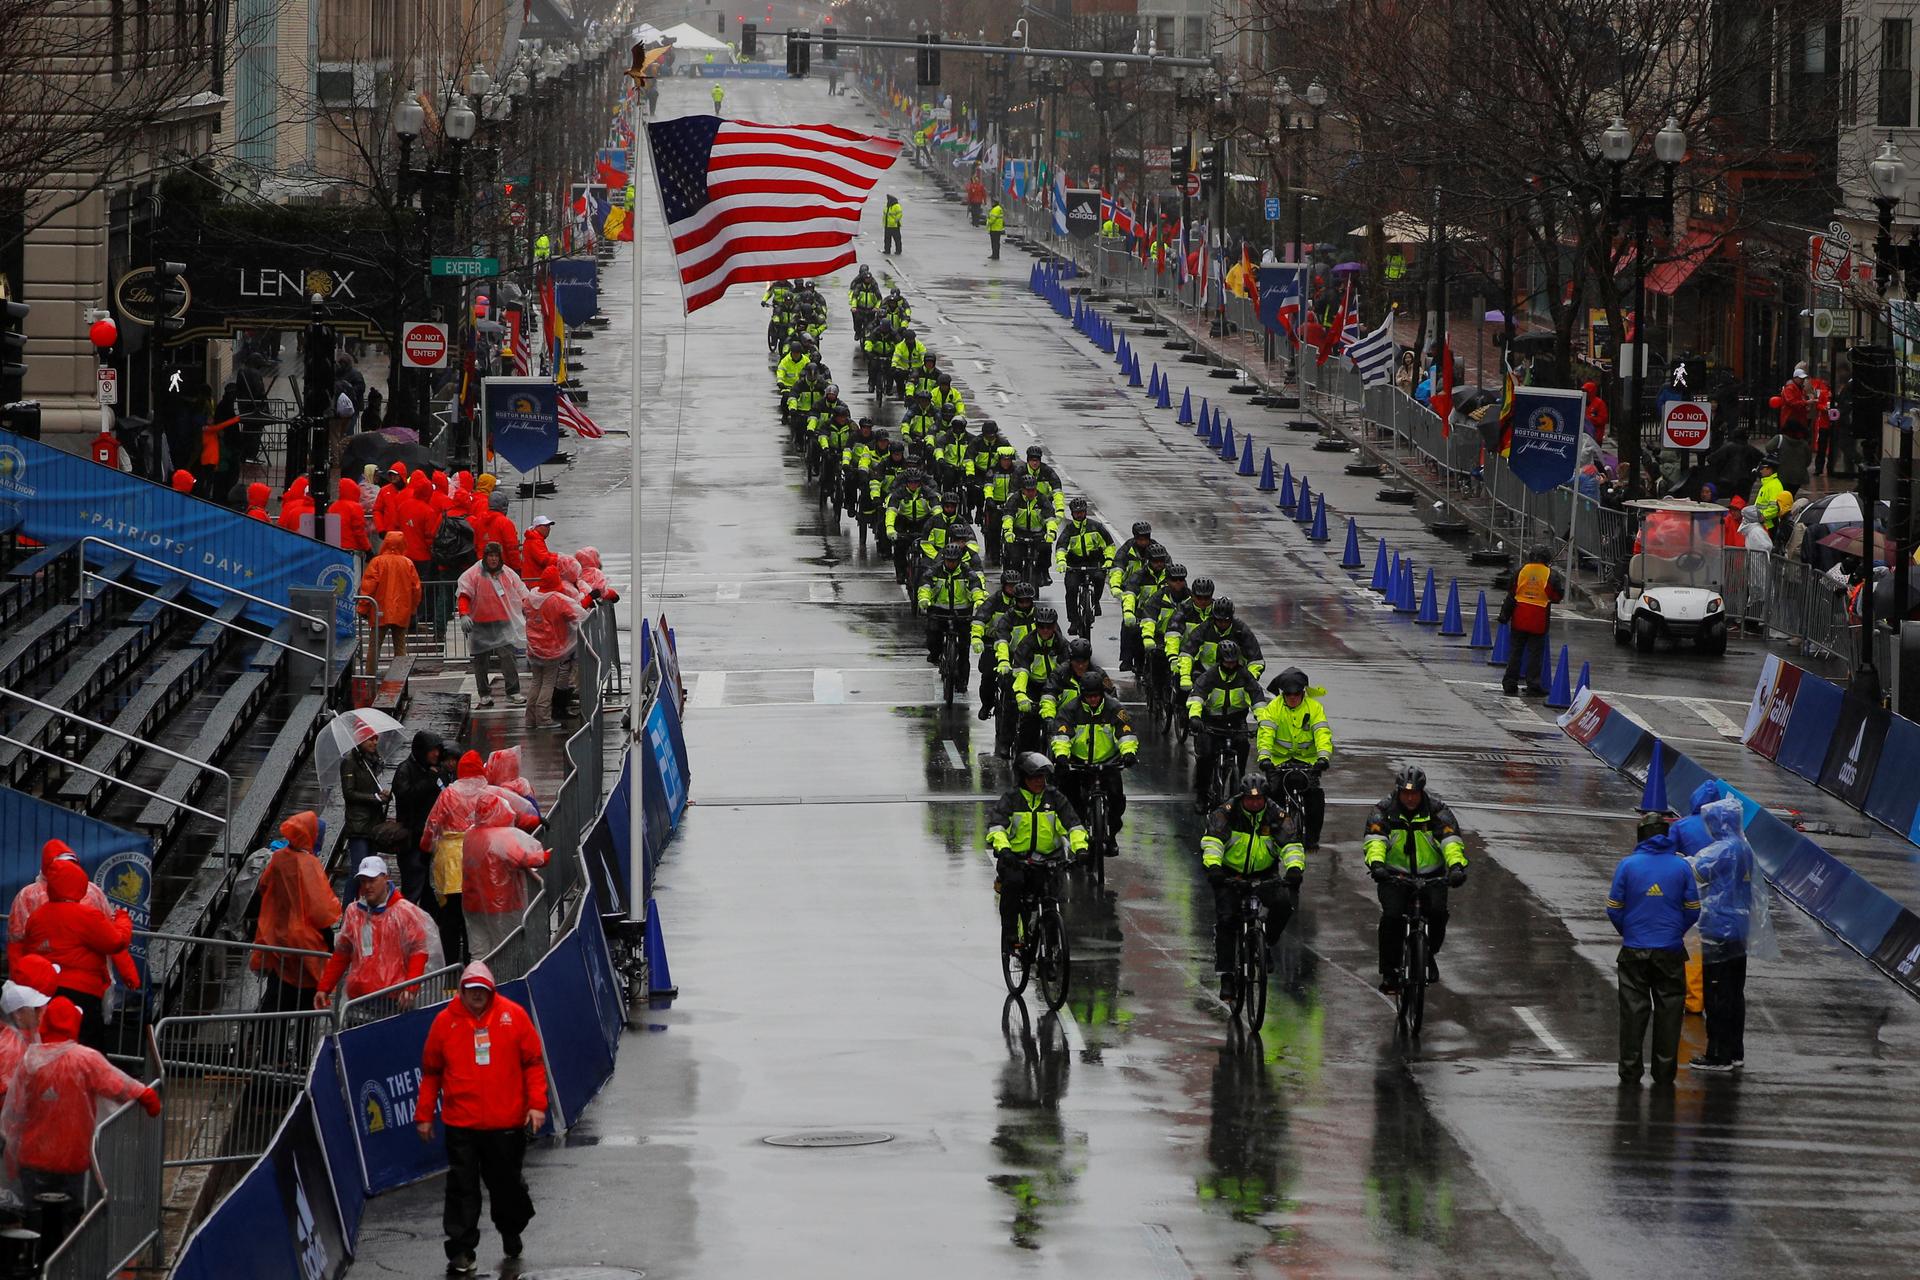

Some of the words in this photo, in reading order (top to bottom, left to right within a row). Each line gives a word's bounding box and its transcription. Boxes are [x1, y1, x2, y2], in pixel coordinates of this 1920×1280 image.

[1068, 212, 1097, 221] adidas
[446, 261, 481, 274] EXETER
[1686, 413, 1704, 421] NOT
[1514, 429, 1539, 437] BOSTON
[1540, 431, 1575, 443] MARATHON
[1673, 430, 1700, 438] ENTER
[202, 552, 242, 575] DAY
[386, 1071, 413, 1098] THE
